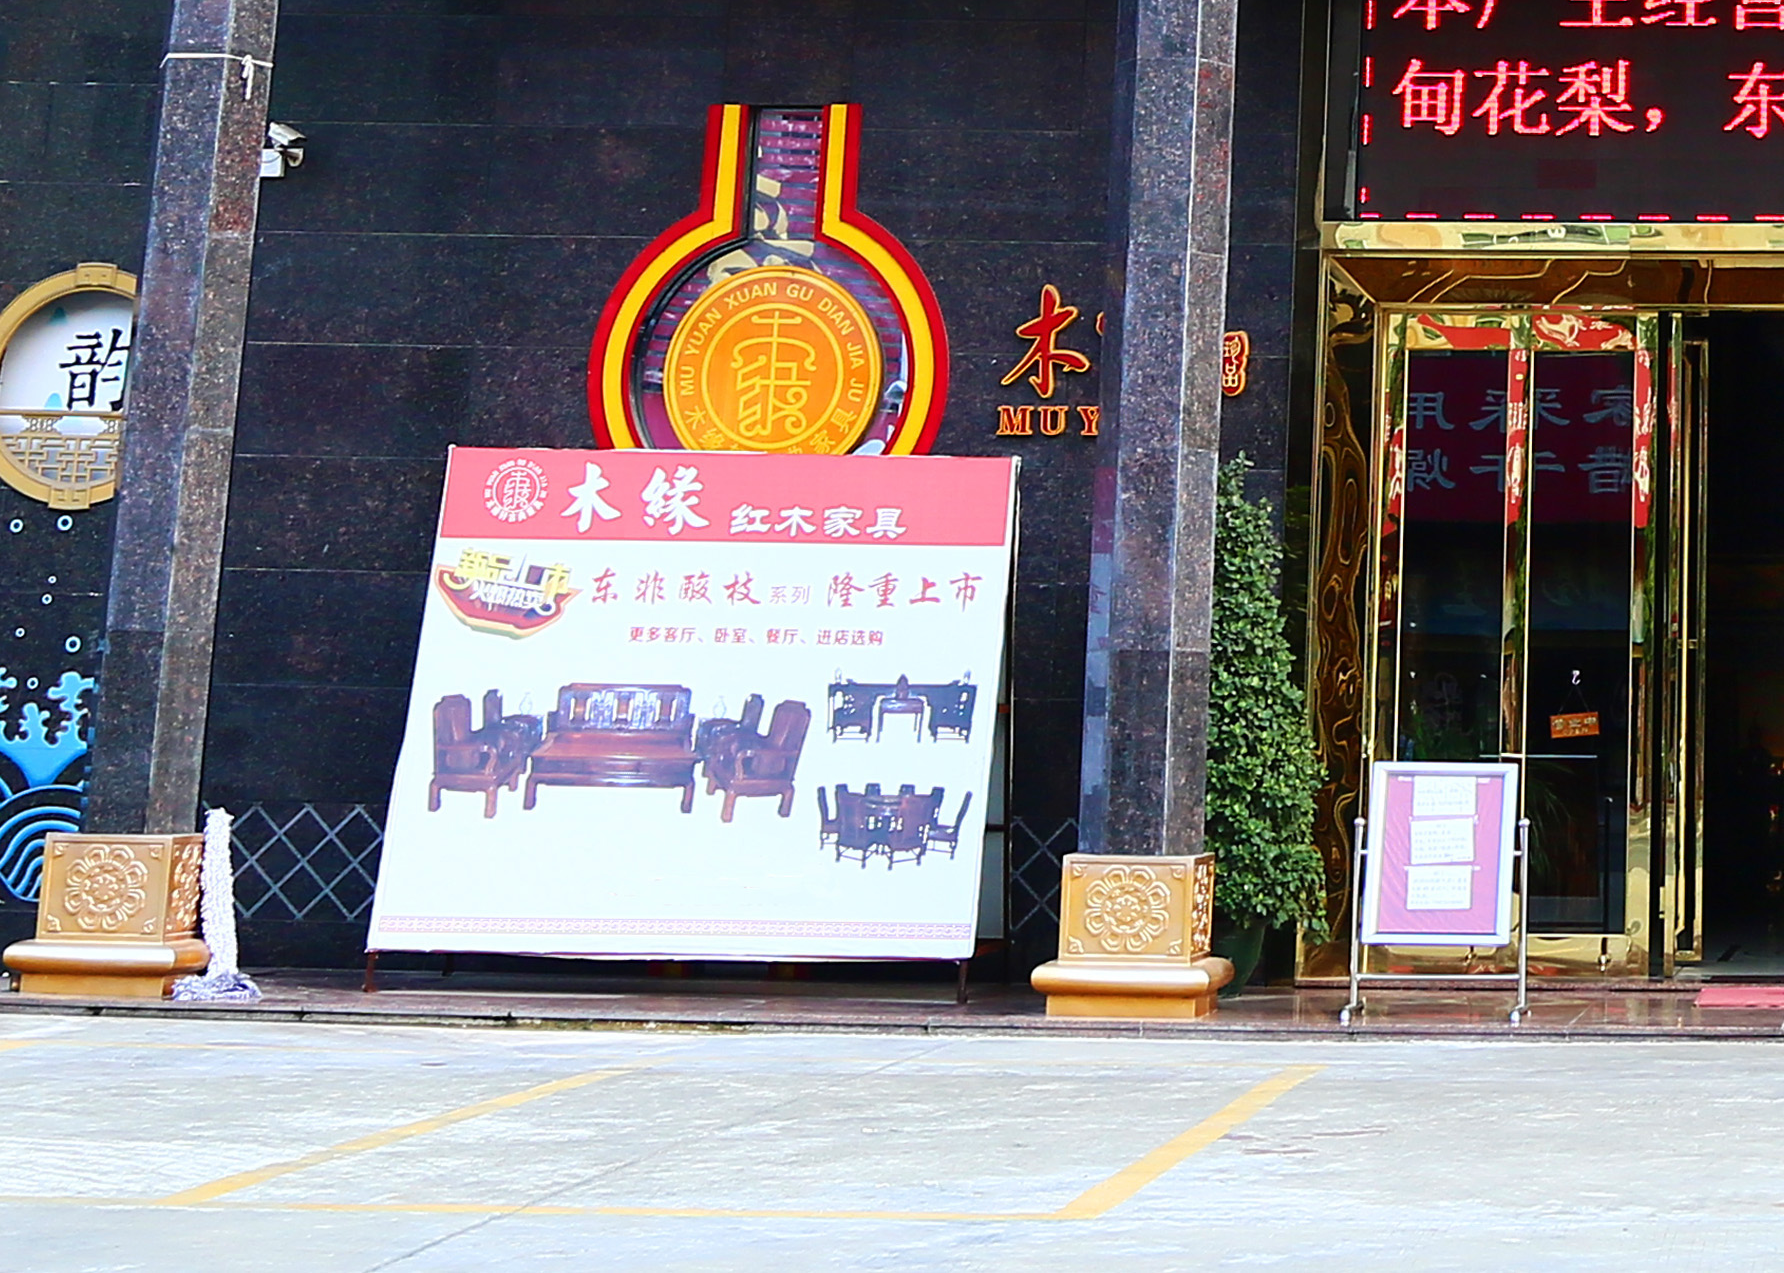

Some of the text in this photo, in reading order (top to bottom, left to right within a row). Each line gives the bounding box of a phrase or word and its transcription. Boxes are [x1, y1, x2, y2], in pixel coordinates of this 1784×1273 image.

[679, 282, 865, 403] MU YUAN XUAN GU DIAN JIA JU
[1001, 284, 1104, 398] 木
[997, 406, 1100, 436] MUY
[729, 504, 908, 540] 红木家具
